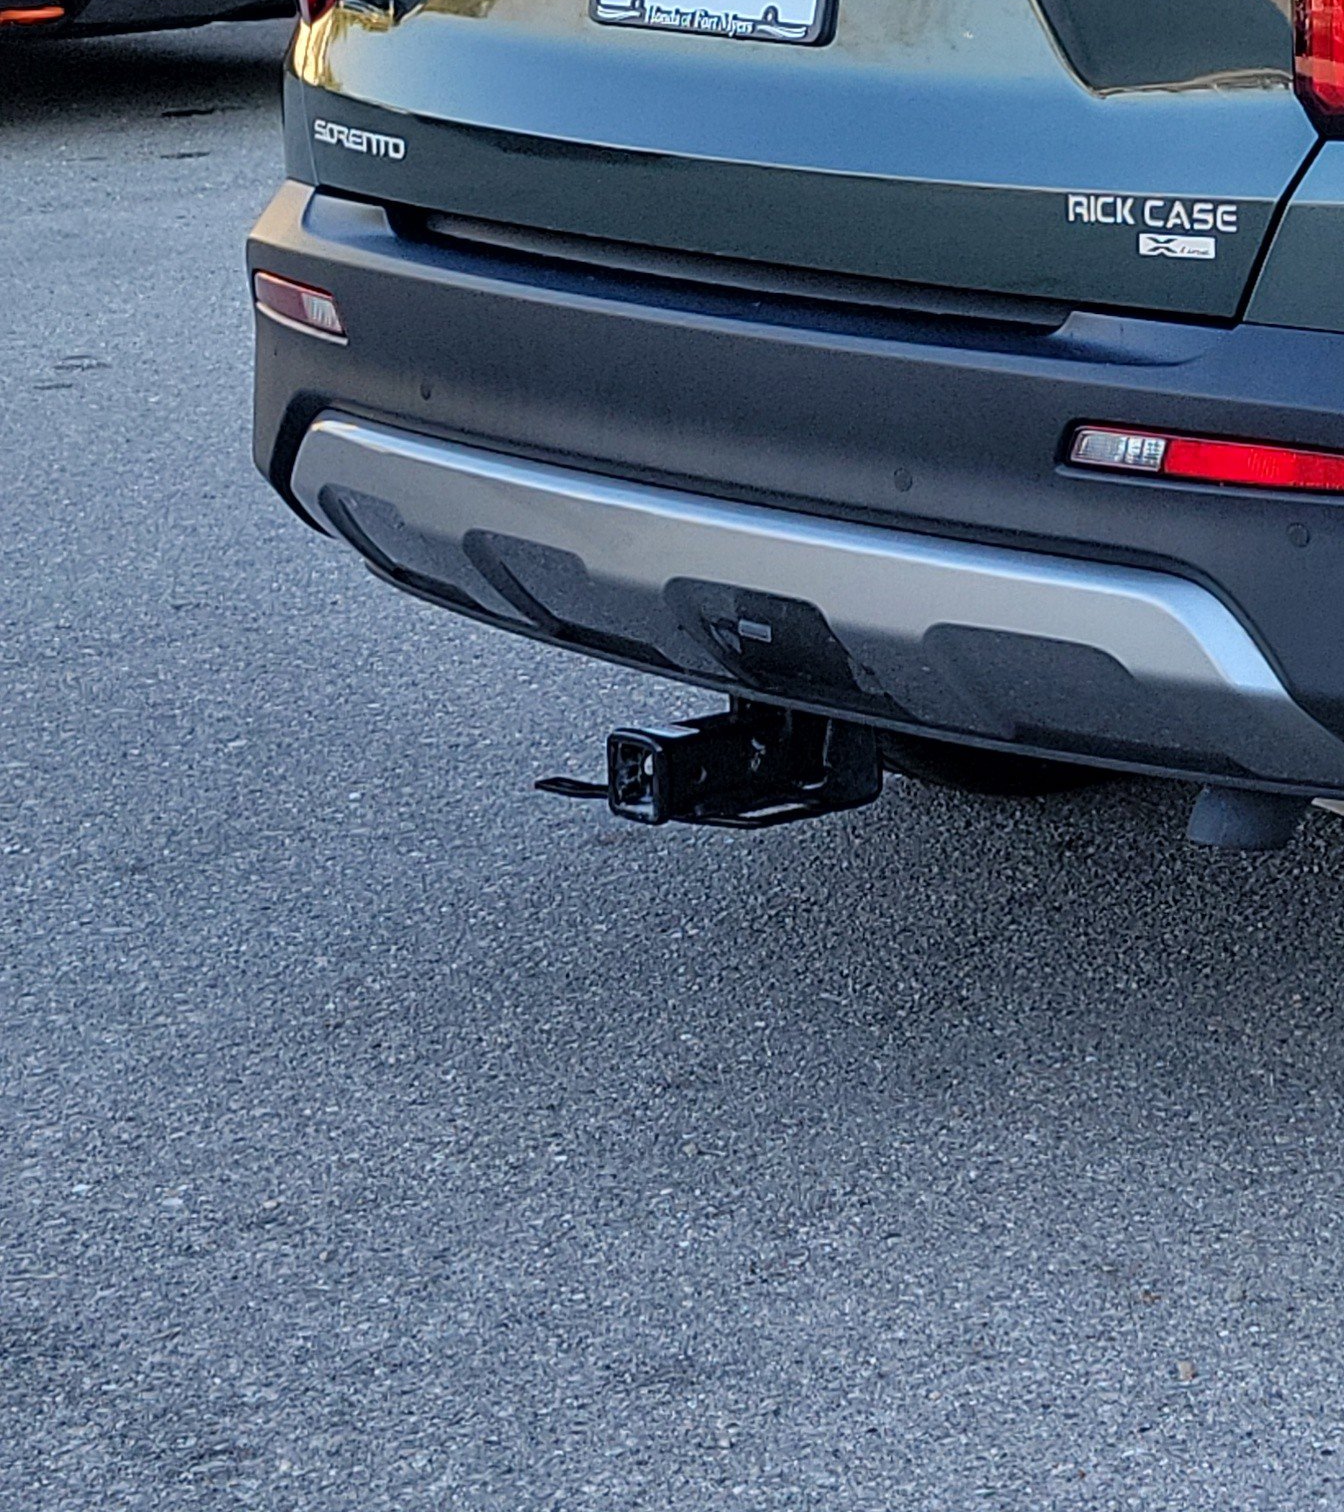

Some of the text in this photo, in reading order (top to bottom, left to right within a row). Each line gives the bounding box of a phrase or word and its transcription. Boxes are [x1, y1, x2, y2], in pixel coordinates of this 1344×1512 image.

[693, 9, 718, 31] Fort
[718, 12, 755, 38] Myers
[313, 118, 406, 160] SORENTO
[1067, 193, 1238, 233] RICK CASE
